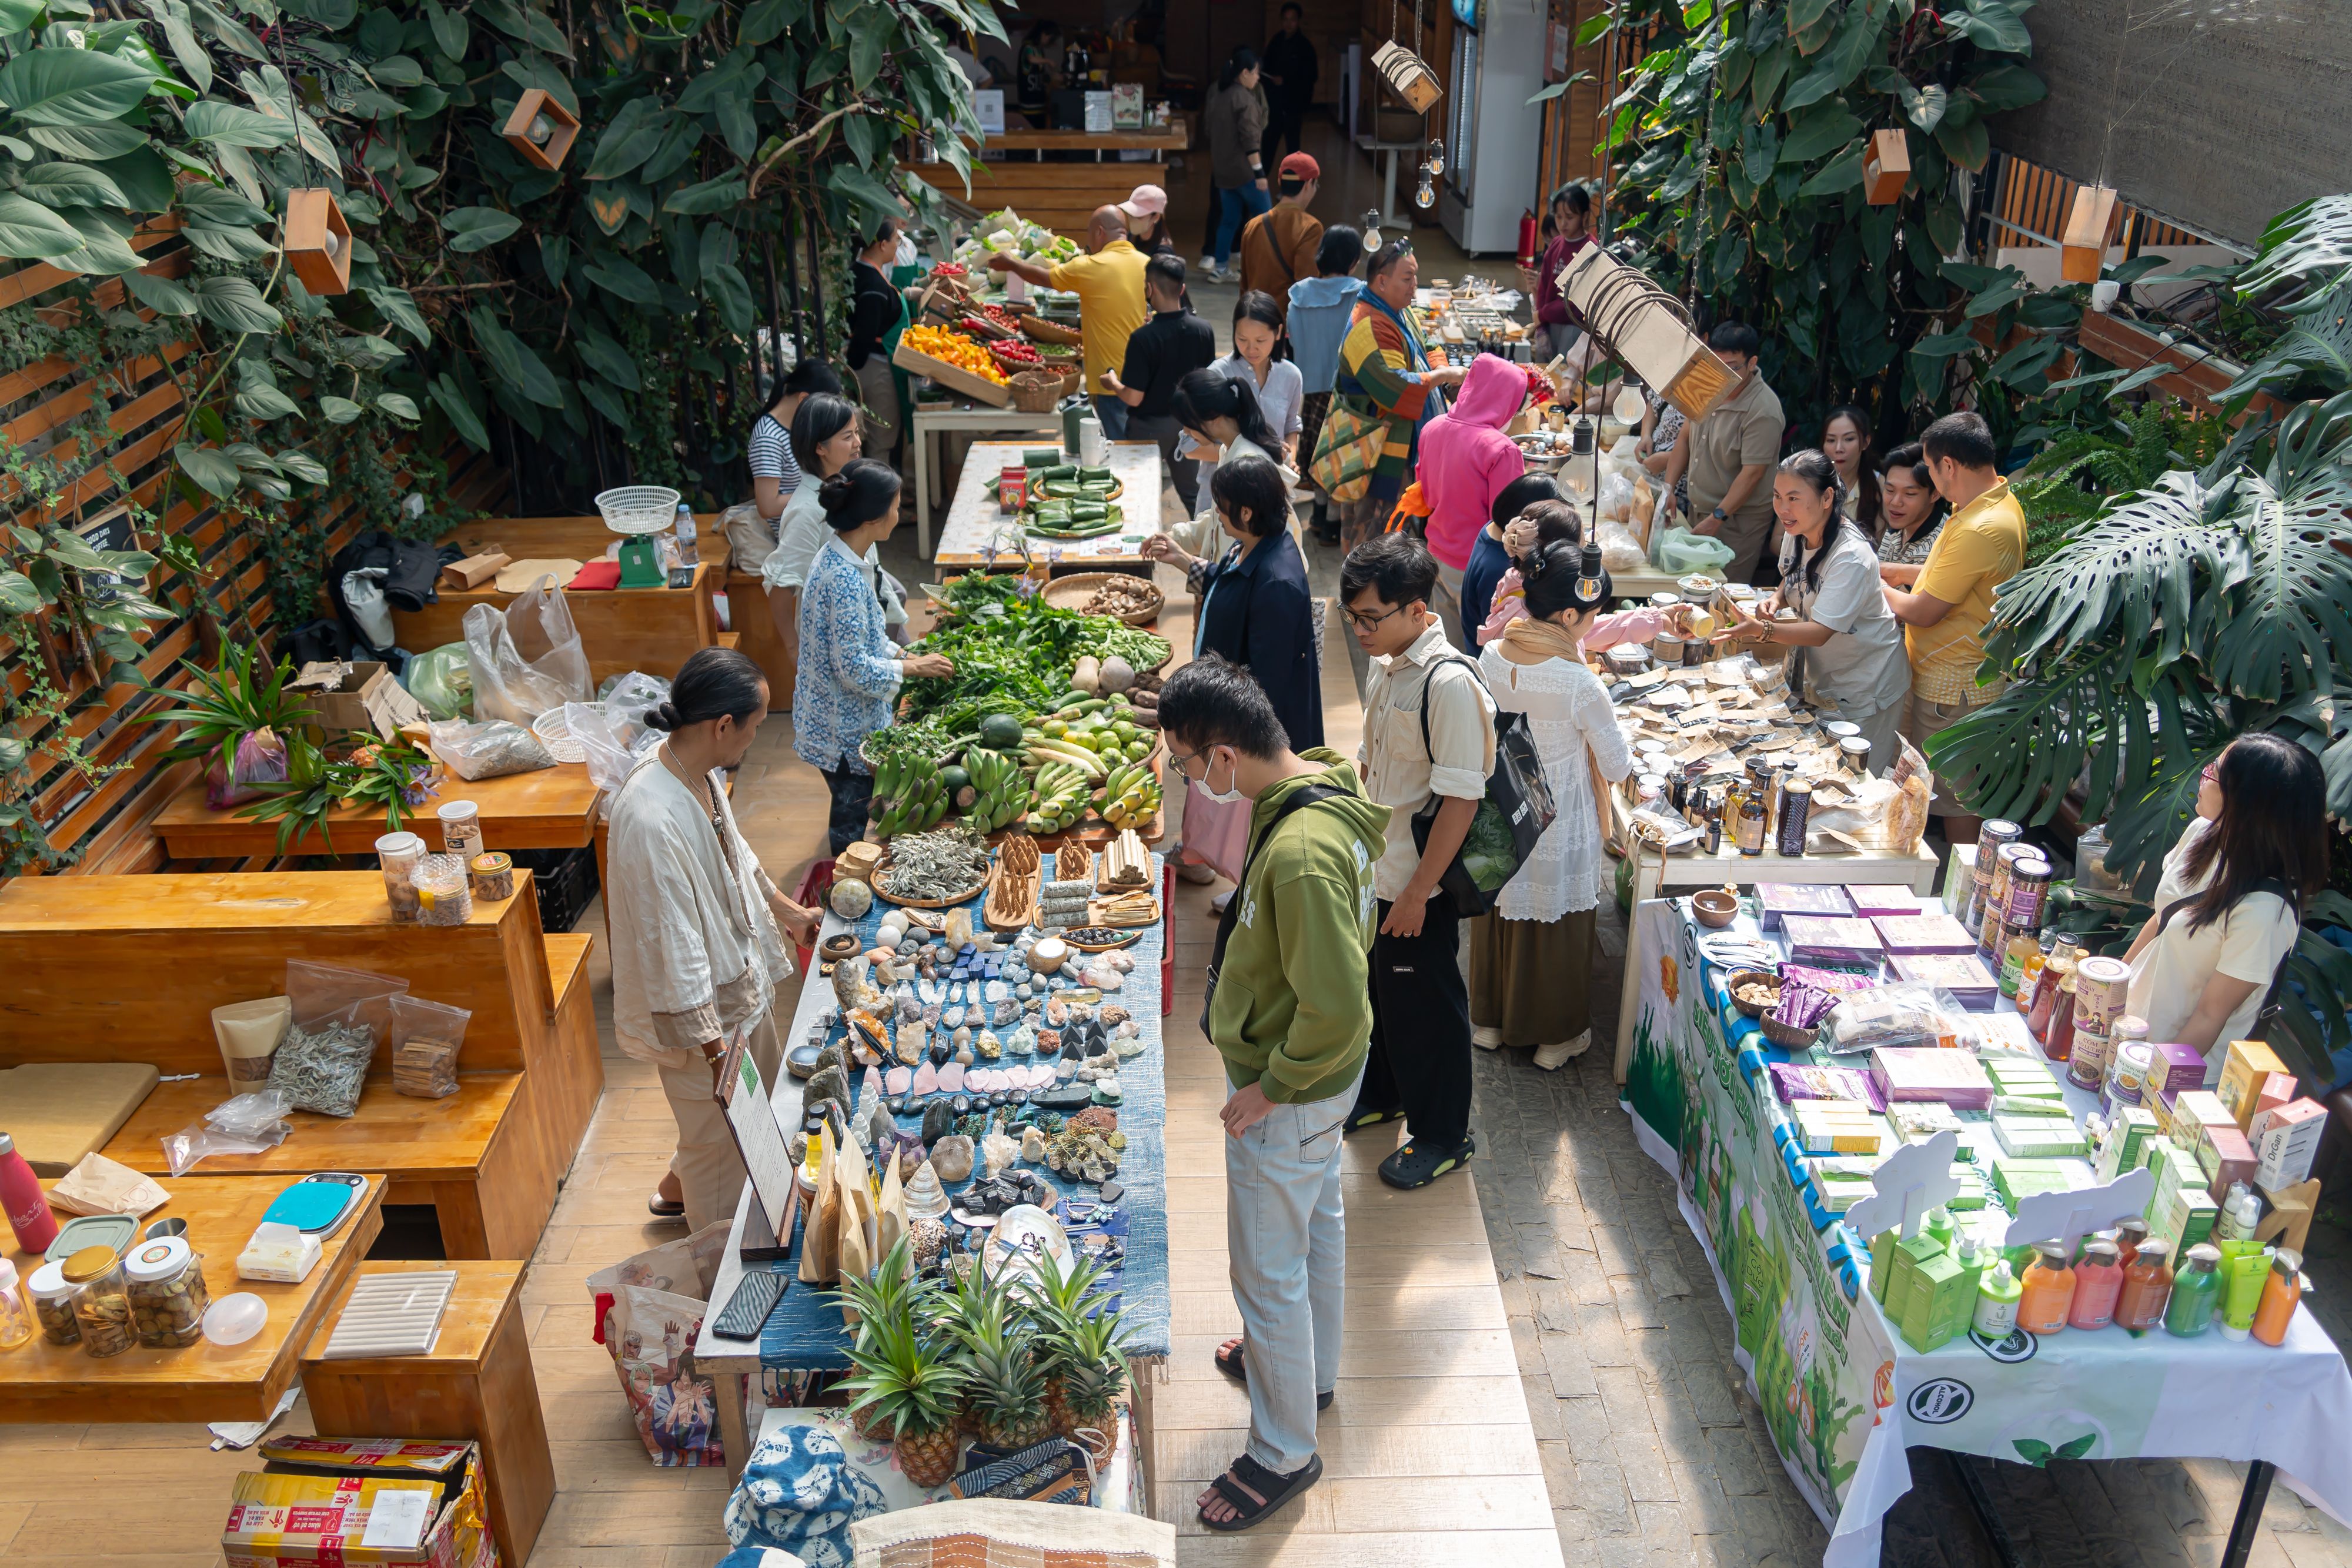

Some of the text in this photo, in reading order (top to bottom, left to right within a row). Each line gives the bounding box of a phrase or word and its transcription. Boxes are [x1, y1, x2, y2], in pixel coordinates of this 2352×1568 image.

[86, 527, 111, 545] GOOD DAYS
[1692, 997, 1716, 1058] SIÊU
[2267, 1133, 2283, 1162] DrGan
[9, 1199, 39, 1226] Heart
[16, 1203, 45, 1229] Soul
[1932, 1386, 1946, 1415] ALCOHOL
